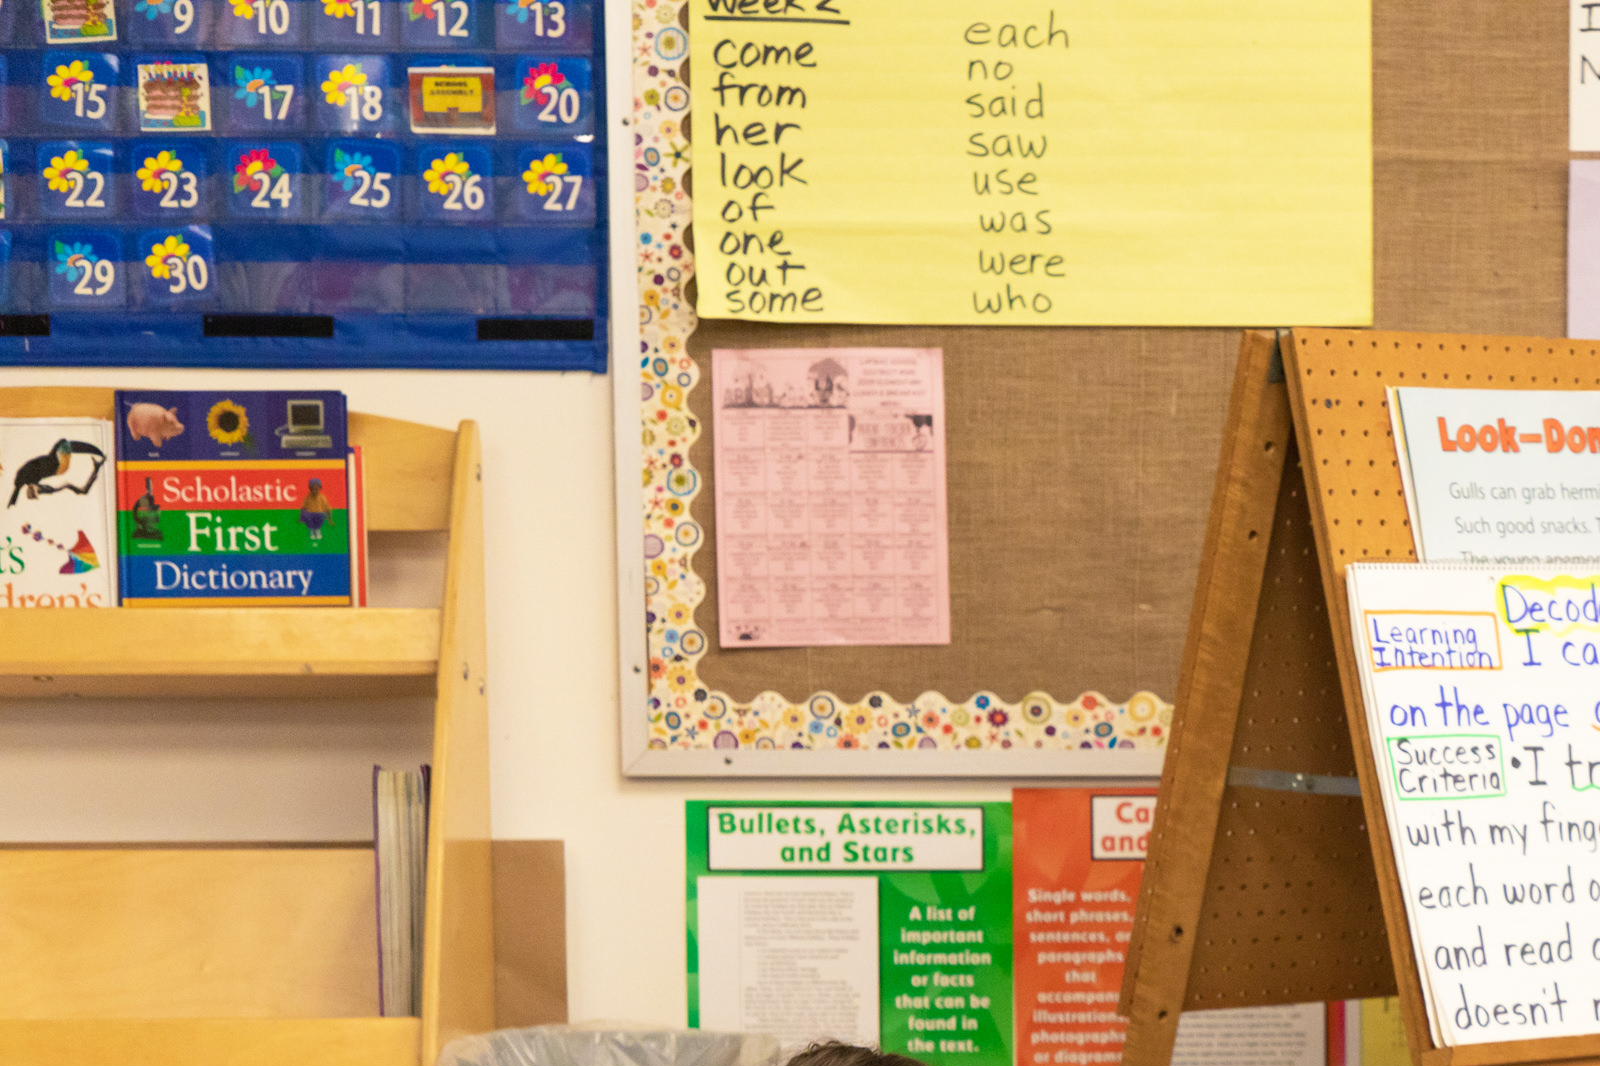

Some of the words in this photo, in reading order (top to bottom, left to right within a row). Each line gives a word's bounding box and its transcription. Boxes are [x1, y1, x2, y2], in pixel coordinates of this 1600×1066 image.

[173, 0, 193, 34] 9
[254, 0, 289, 35] 10
[354, 2, 380, 36] 11
[435, 0, 468, 37] 12
[531, 2, 565, 38] 13
[964, 10, 1069, 49] each
[714, 39, 817, 68] come
[968, 59, 1013, 80] no
[73, 83, 106, 119] 15
[260, 85, 294, 120] 17
[347, 86, 382, 121] 18
[712, 71, 806, 108] from
[965, 83, 1043, 119] said
[540, 86, 578, 123] 20
[714, 113, 801, 146] her
[967, 132, 1046, 158] saw
[720, 152, 808, 189] look
[974, 169, 1039, 195] use
[69, 172, 105, 207] 22
[160, 173, 198, 208] 23
[253, 173, 292, 208] 24
[352, 171, 391, 208] 25
[445, 174, 483, 210] 26
[544, 175, 582, 210] 27
[721, 193, 776, 223] of
[980, 209, 1052, 236] was
[720, 228, 793, 256] one
[77, 259, 114, 295] 29
[169, 255, 208, 293] 30
[726, 260, 805, 287] out
[979, 248, 1066, 277] were
[725, 286, 823, 313] some
[973, 283, 1053, 314] who
[163, 476, 297, 502] Scholastic
[1449, 482, 1485, 500] Gulls
[1490, 485, 1516, 500] can
[1522, 482, 1556, 503] grab
[186, 512, 278, 552] First
[1454, 516, 1491, 534] Such
[1496, 516, 1536, 537] good
[1540, 517, 1591, 534] snacks.
[154, 561, 313, 595] Dictionary
[1374, 617, 1477, 650] Learning
[1522, 629, 1541, 667] I
[1372, 646, 1494, 669] Intention
[1389, 699, 1425, 727] on
[1435, 685, 1490, 727] the
[1504, 700, 1570, 741] page
[1396, 738, 1496, 767] Success
[1400, 767, 1500, 794] Criteria
[718, 812, 825, 837] Bullets,
[838, 813, 975, 837] Asterisks,
[1407, 809, 1475, 846] with
[1490, 822, 1528, 855] my
[781, 842, 830, 862] and
[843, 841, 914, 862] Stars
[1419, 863, 1488, 909] each
[1503, 866, 1574, 906] word
[926, 906, 952, 921] list
[901, 928, 983, 945] important
[1435, 926, 1487, 970] and
[1505, 923, 1573, 967] read
[894, 950, 991, 965] information
[1038, 950, 1124, 965] paragraphs
[933, 972, 974, 987] facts
[896, 994, 929, 1009] that
[935, 997, 964, 1008] can
[1455, 982, 1567, 1029] doesn't
[908, 1016, 956, 1030] found
[940, 1039, 979, 1053] text.
